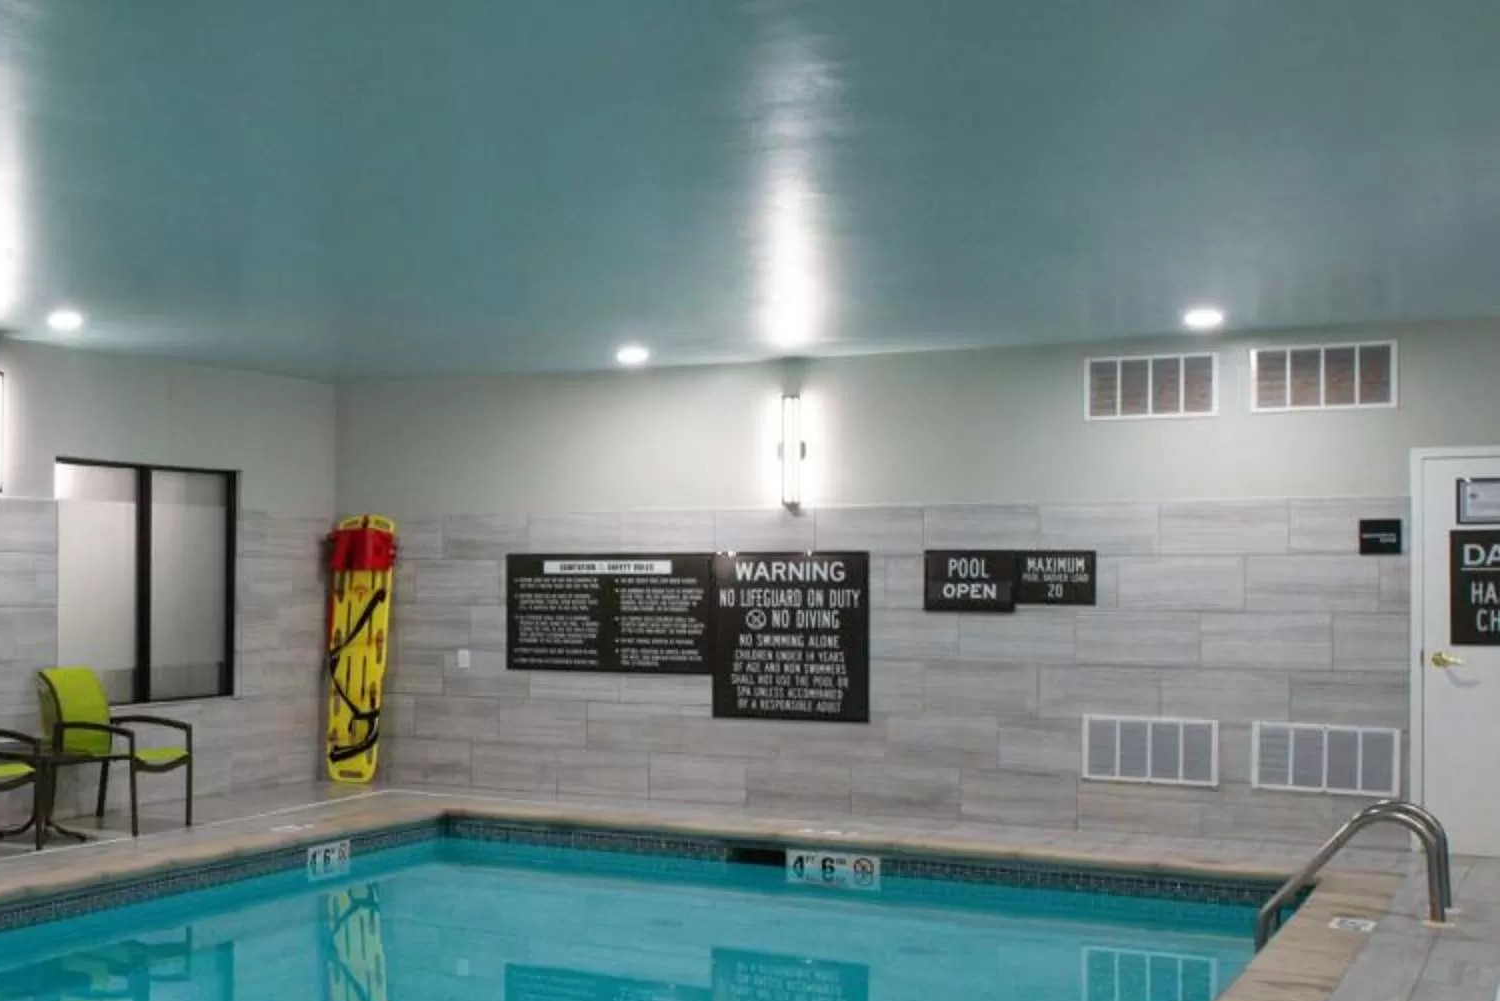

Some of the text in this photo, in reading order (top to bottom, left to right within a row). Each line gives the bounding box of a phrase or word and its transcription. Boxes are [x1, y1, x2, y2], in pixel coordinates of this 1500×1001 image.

[735, 561, 846, 582] WARNING
[947, 557, 990, 579] POOL
[1027, 556, 1085, 573] MAXIMUM
[719, 588, 735, 607] NO
[740, 588, 801, 608] LIFEGUARD
[807, 589, 824, 608] ON
[829, 589, 861, 608] DUTY
[942, 583, 997, 600] OPEN
[1047, 583, 1064, 598] 20
[772, 610, 841, 629] NO DIVING
[739, 634, 840, 648] NO SWIMMING ALONE
[735, 649, 773, 660] CHILDREN
[776, 650, 802, 661] UNDER
[817, 651, 844, 662] YEARS
[733, 662, 743, 672] OF
[746, 662, 761, 673] AGE
[765, 662, 781, 673] AND
[804, 663, 847, 675] SWIMMERS
[731, 673, 755, 685] SHALL
[758, 674, 773, 685] NOT
[775, 675, 791, 686] USE
[795, 675, 809, 686] THE
[813, 676, 833, 687] POOL
[737, 685, 843, 700] SPA UNLESS ACCOMPANIED
[759, 699, 813, 712] RESPONSIBLE
[816, 700, 841, 713] ADULT
